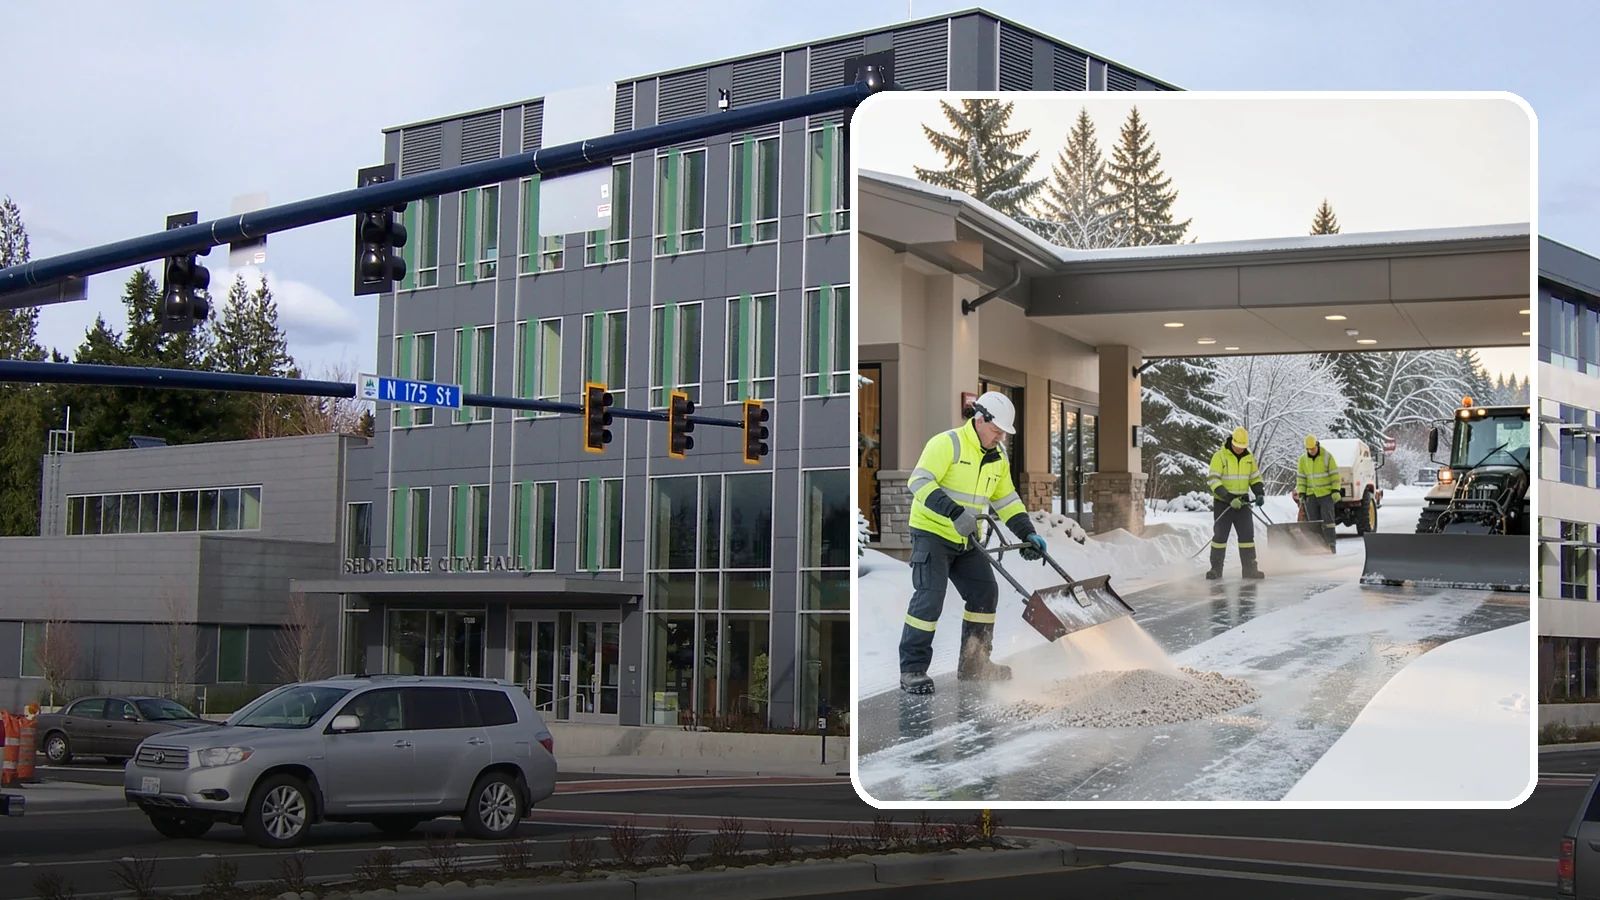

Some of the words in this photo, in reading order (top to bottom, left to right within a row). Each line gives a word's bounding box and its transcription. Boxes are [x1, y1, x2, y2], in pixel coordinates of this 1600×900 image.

[387, 380, 396, 400] N
[405, 382, 427, 403] 175
[436, 386, 451, 406] St
[343, 556, 432, 575] SHORELINE
[438, 556, 475, 572] CITY
[484, 555, 526, 571] HALL
